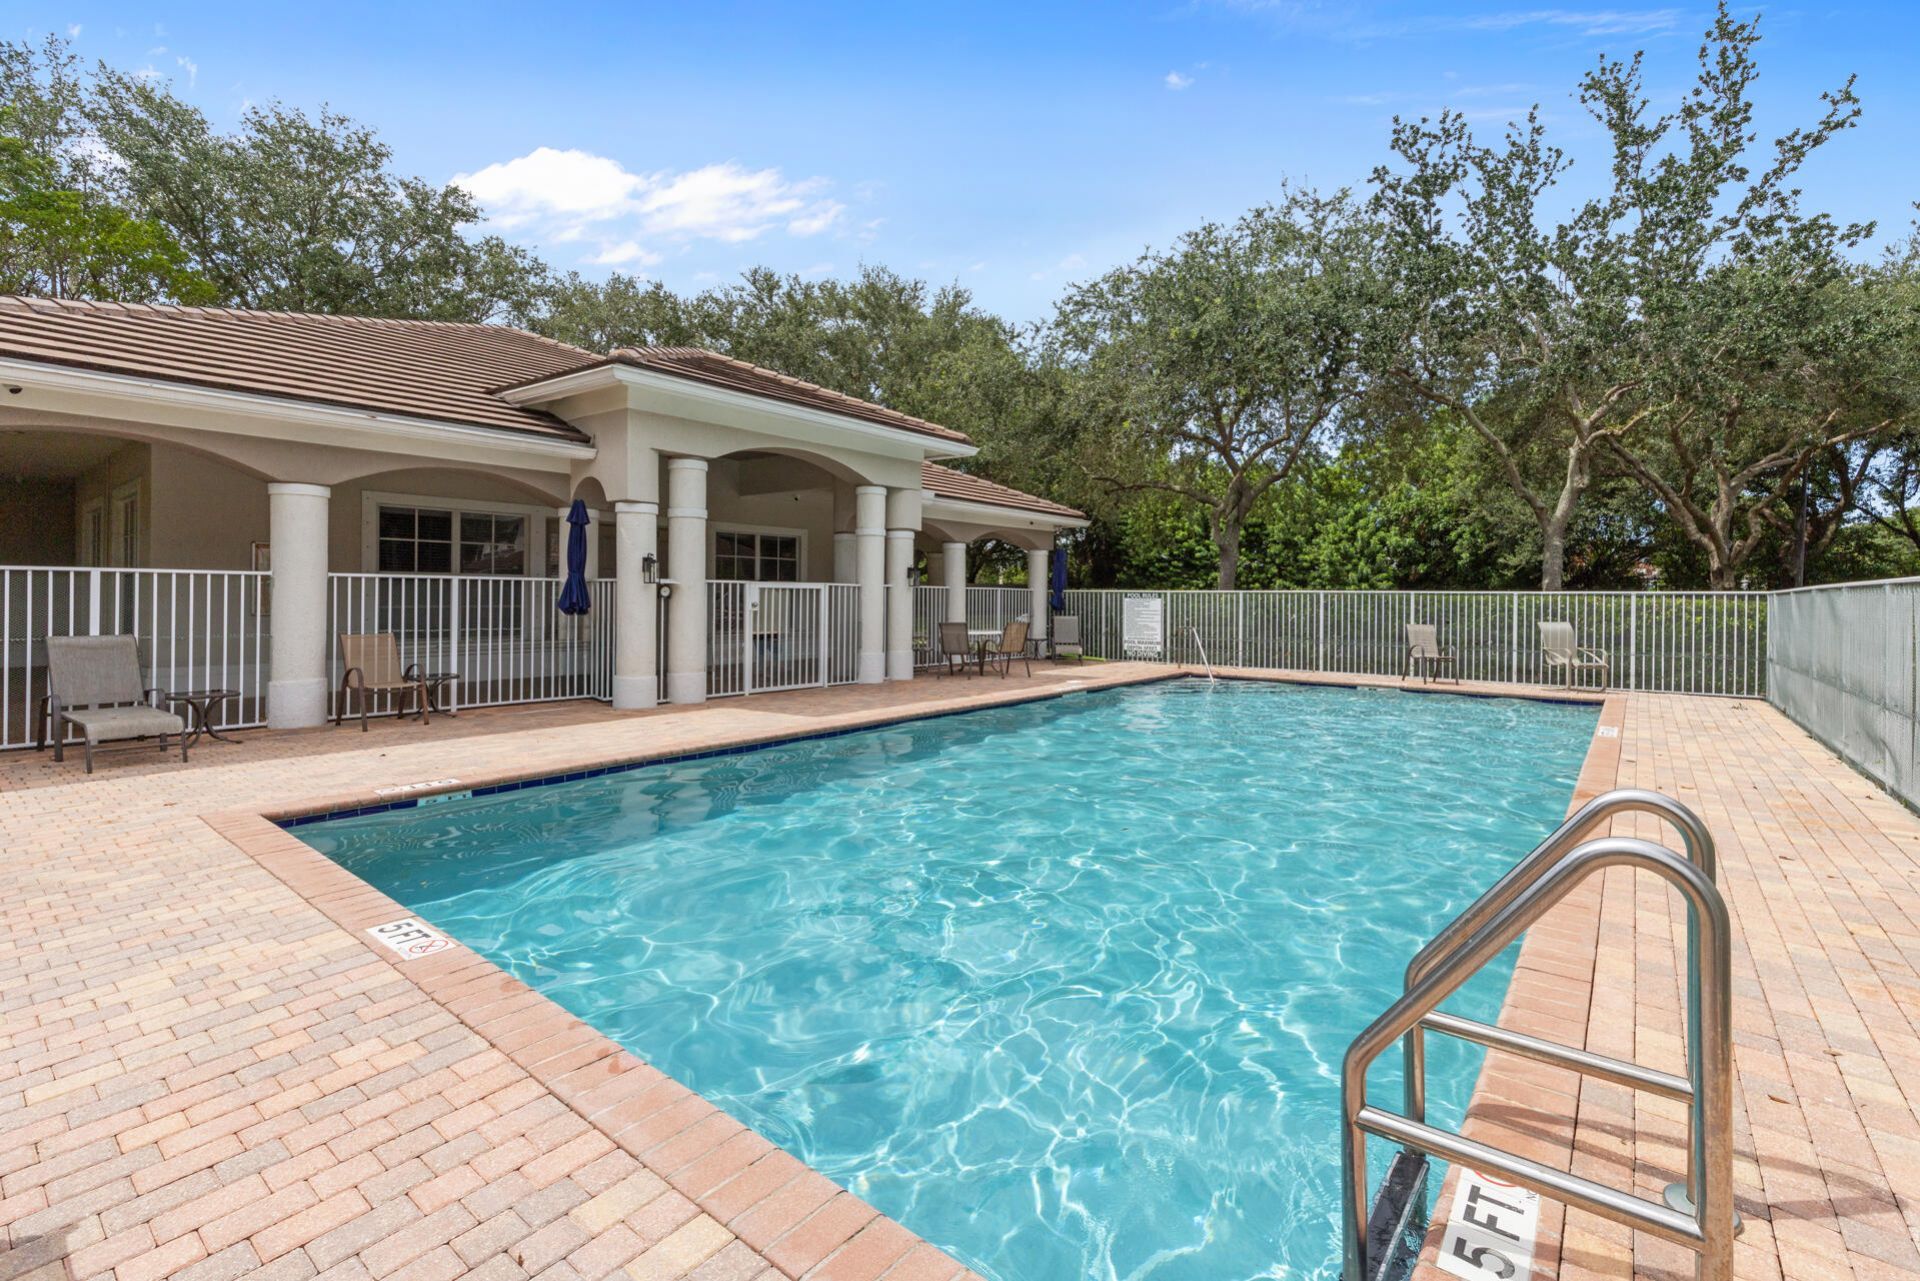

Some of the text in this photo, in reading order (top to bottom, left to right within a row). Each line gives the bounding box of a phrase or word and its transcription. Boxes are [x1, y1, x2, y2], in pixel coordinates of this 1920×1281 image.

[378, 922, 432, 945] 5 FT
[1453, 1237, 1515, 1279] 5
